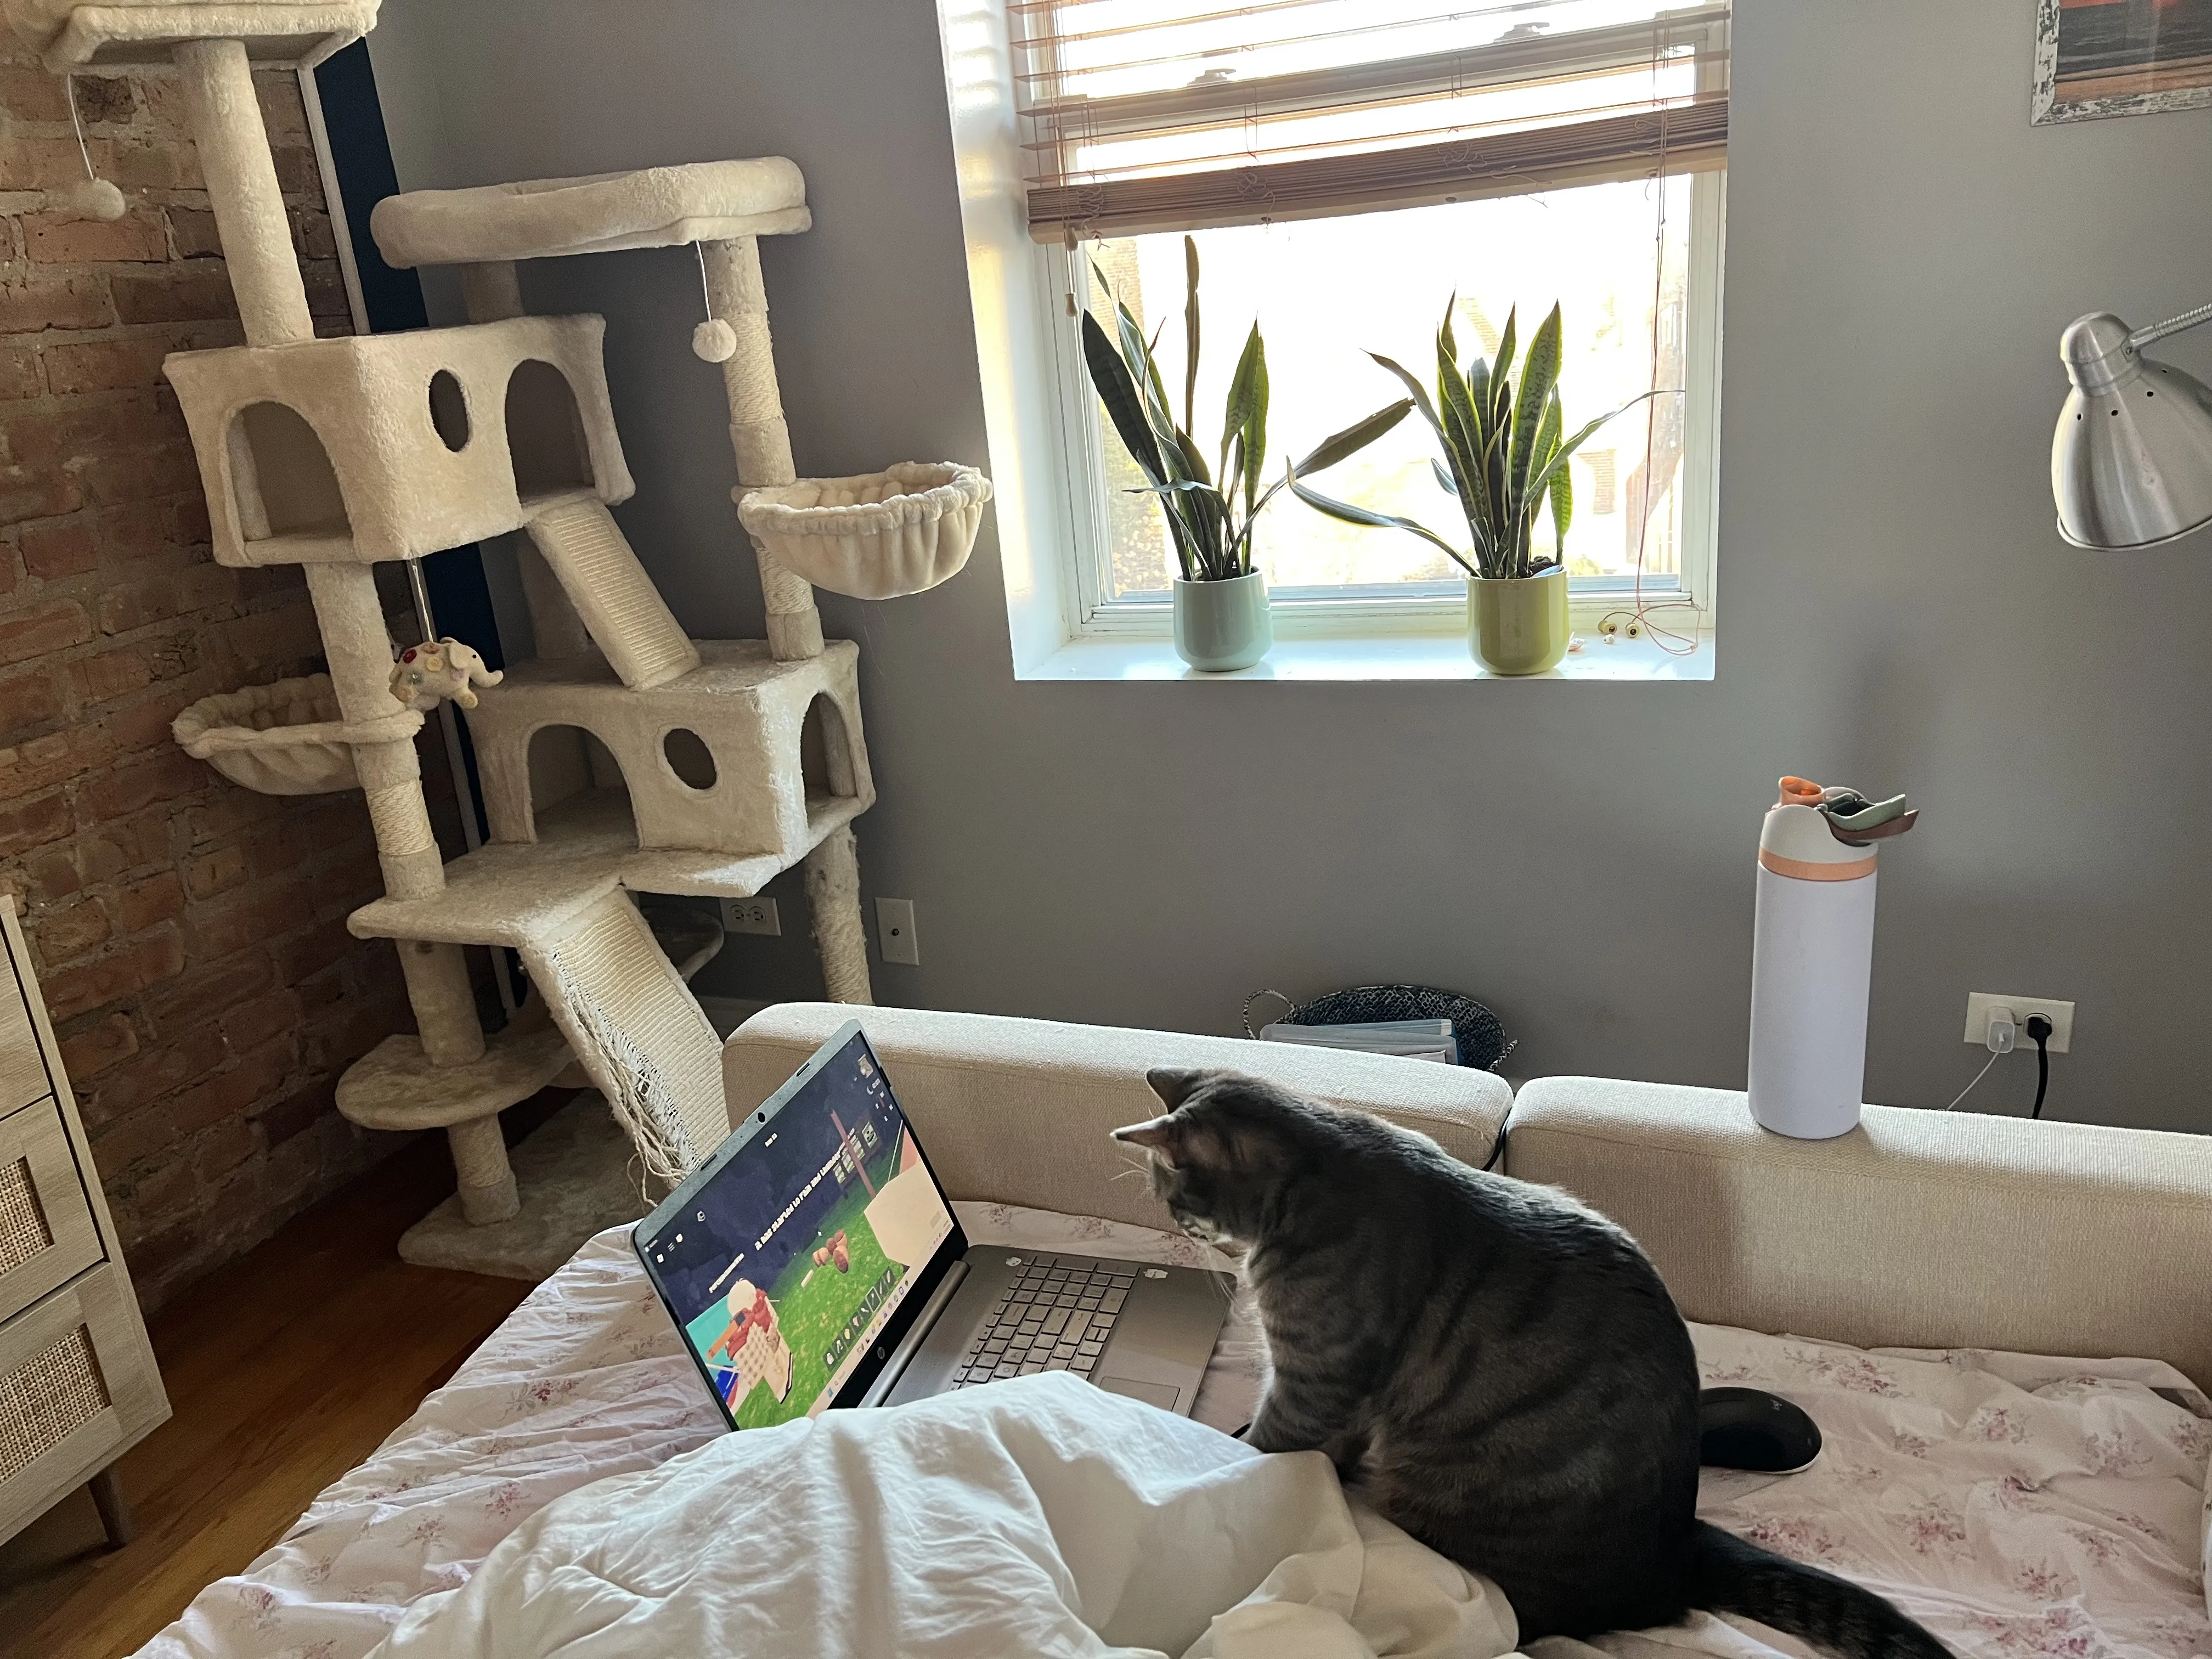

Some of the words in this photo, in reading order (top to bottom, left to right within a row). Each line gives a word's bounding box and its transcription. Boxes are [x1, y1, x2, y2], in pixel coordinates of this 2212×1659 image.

[771, 1204, 794, 1232] started
[792, 1197, 800, 1207] to
[799, 1184, 812, 1201] rain
[810, 1172, 822, 1188] and
